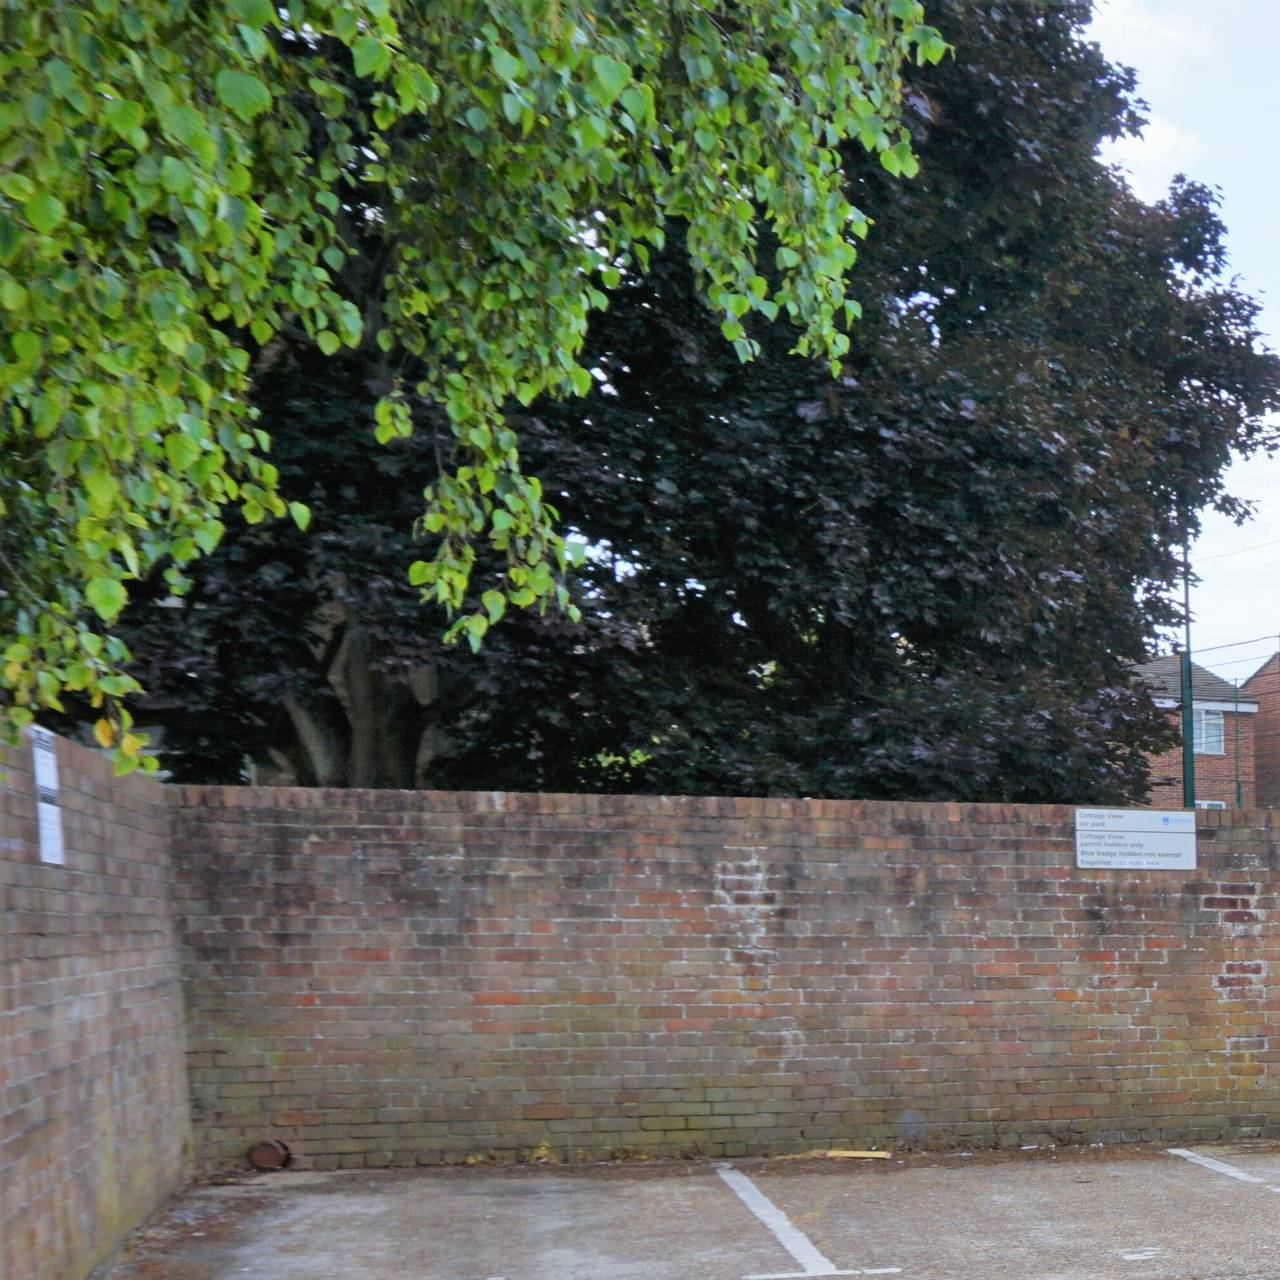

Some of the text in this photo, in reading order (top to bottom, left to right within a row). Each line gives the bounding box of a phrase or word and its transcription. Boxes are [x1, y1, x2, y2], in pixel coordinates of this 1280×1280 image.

[1080, 812, 1105, 820] Cottage
[1091, 820, 1105, 828] park
[1080, 833, 1106, 841] Cottage
[1097, 850, 1117, 858] badge
